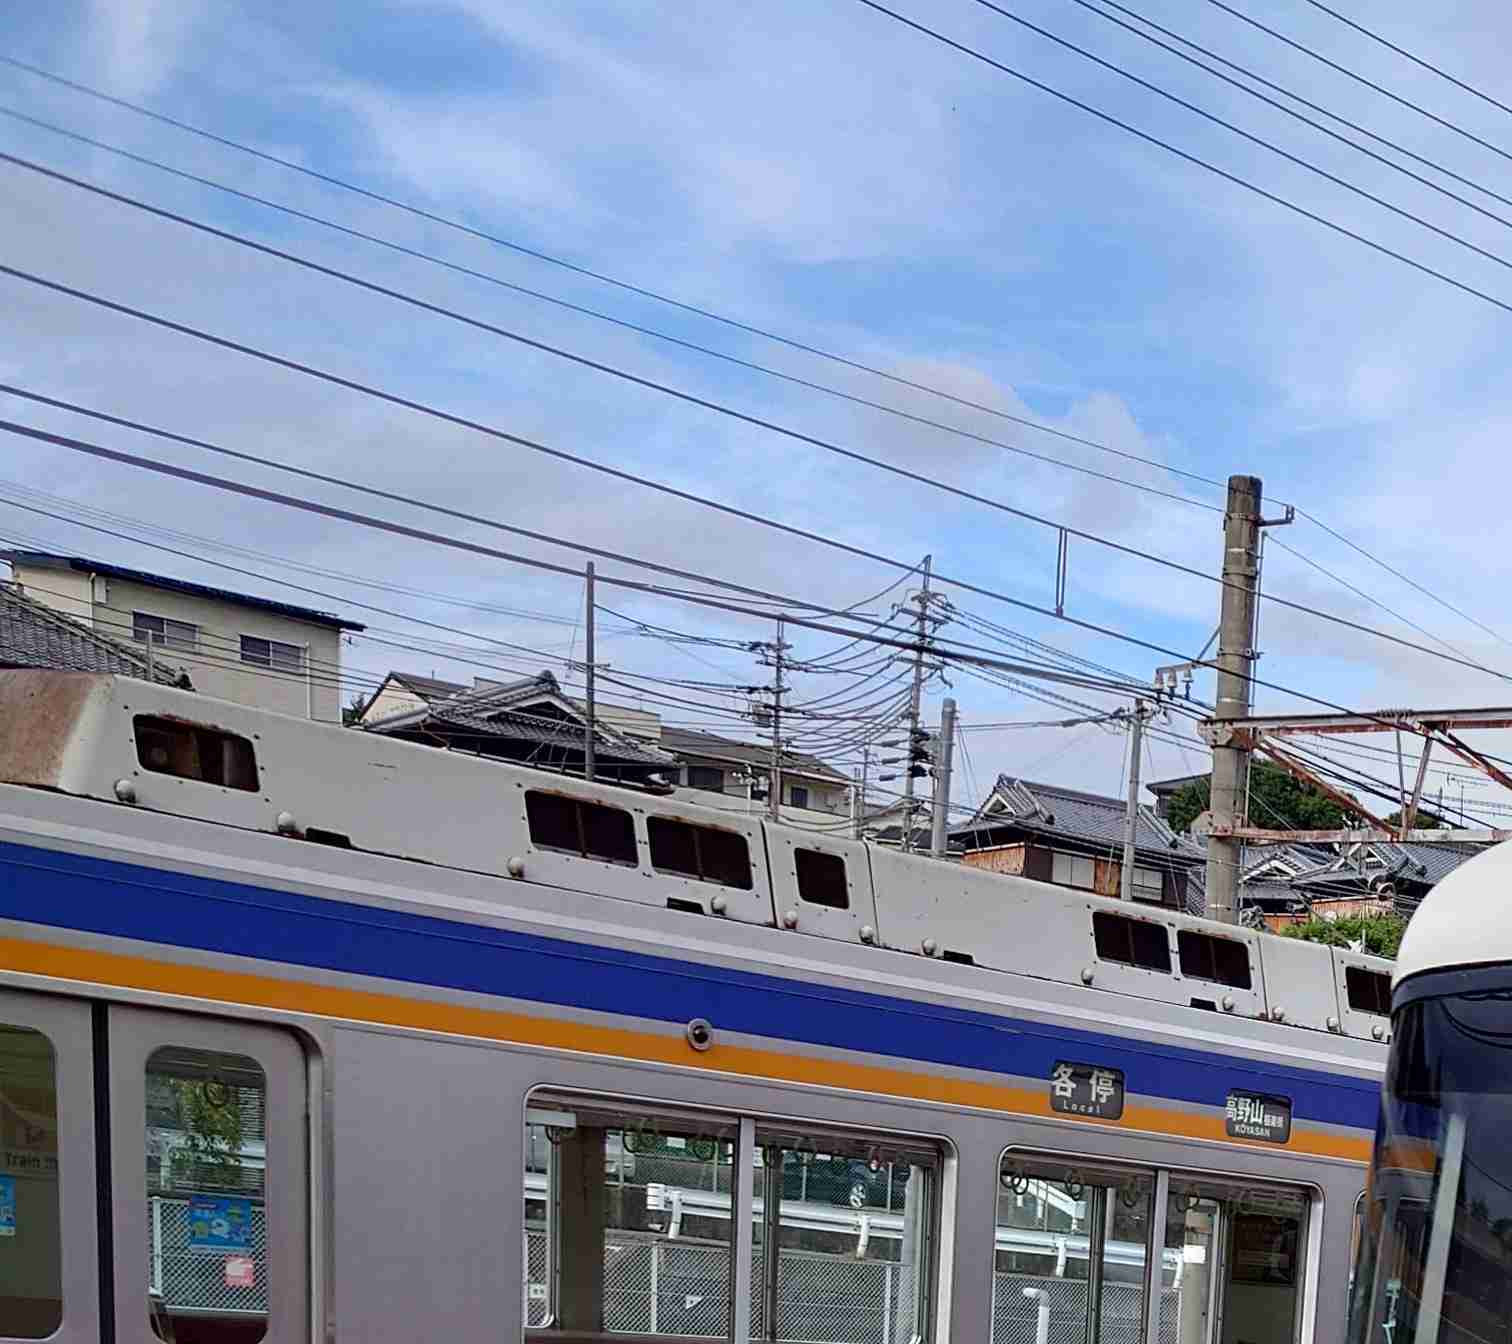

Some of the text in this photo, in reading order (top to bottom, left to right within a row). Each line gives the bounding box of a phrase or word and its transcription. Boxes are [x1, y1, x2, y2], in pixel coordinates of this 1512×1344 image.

[1052, 1064, 1115, 1104] 各停
[1063, 1099, 1101, 1114] Local
[1225, 1095, 1265, 1124] 高野山
